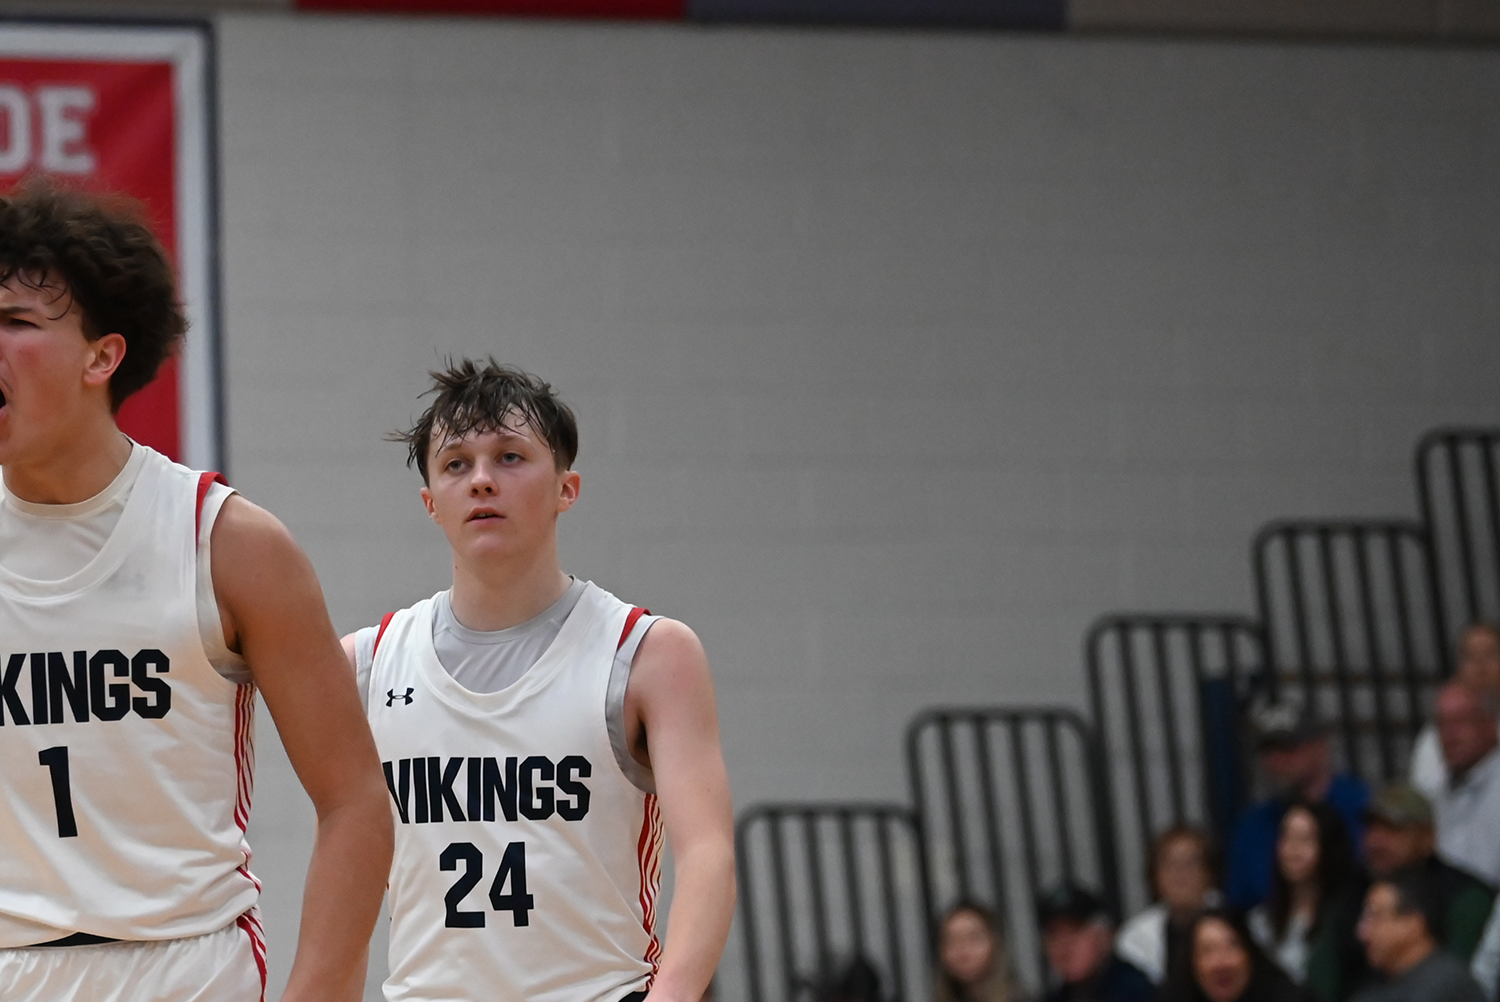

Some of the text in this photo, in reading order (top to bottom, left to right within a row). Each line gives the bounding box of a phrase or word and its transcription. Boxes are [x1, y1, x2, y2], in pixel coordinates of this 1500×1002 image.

[37, 745, 78, 838] 1
[381, 754, 593, 825] VIKINGS
[439, 841, 535, 929] 24
